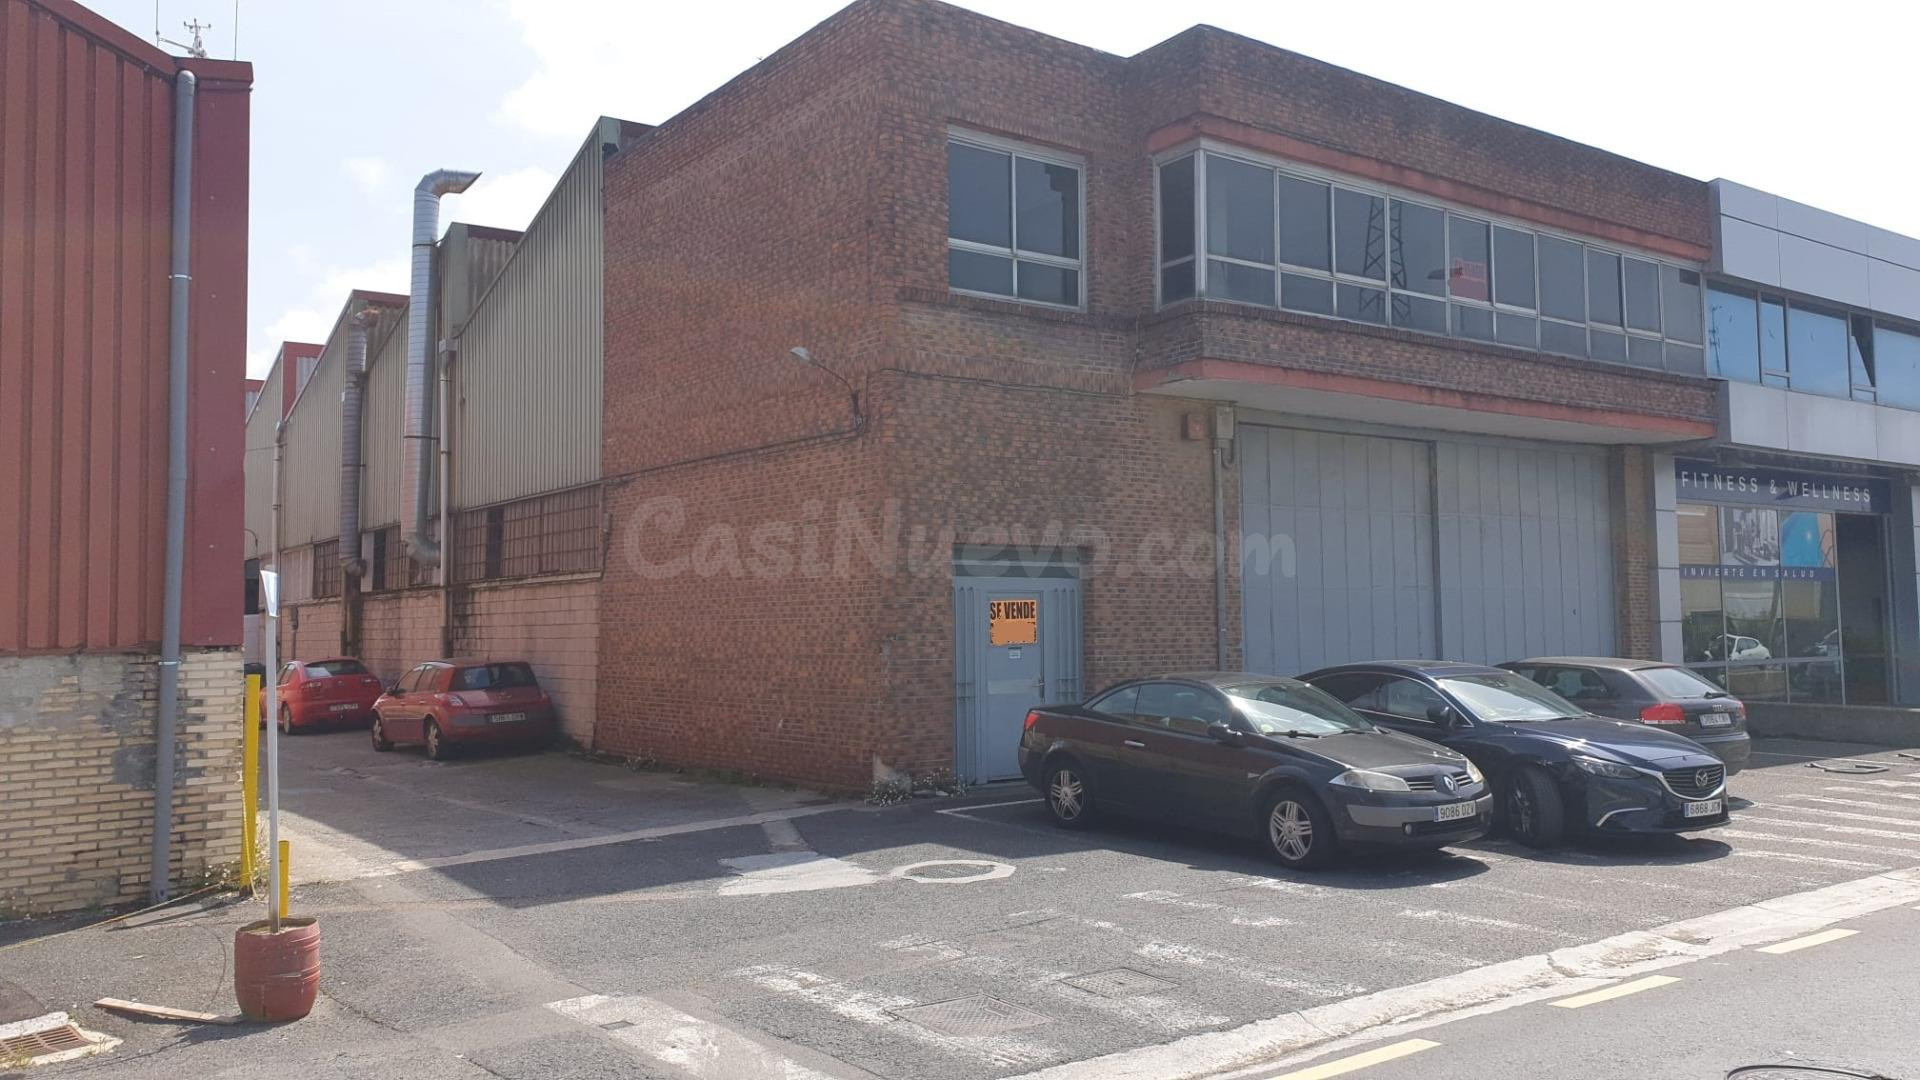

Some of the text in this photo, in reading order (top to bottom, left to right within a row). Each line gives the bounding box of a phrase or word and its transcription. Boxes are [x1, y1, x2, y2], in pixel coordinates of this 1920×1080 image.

[1681, 471, 1871, 502] FITNESS & WELLNESS
[1684, 567, 1815, 578] INVIERTE EN SALUD
[1004, 601, 1036, 619] VENDE
